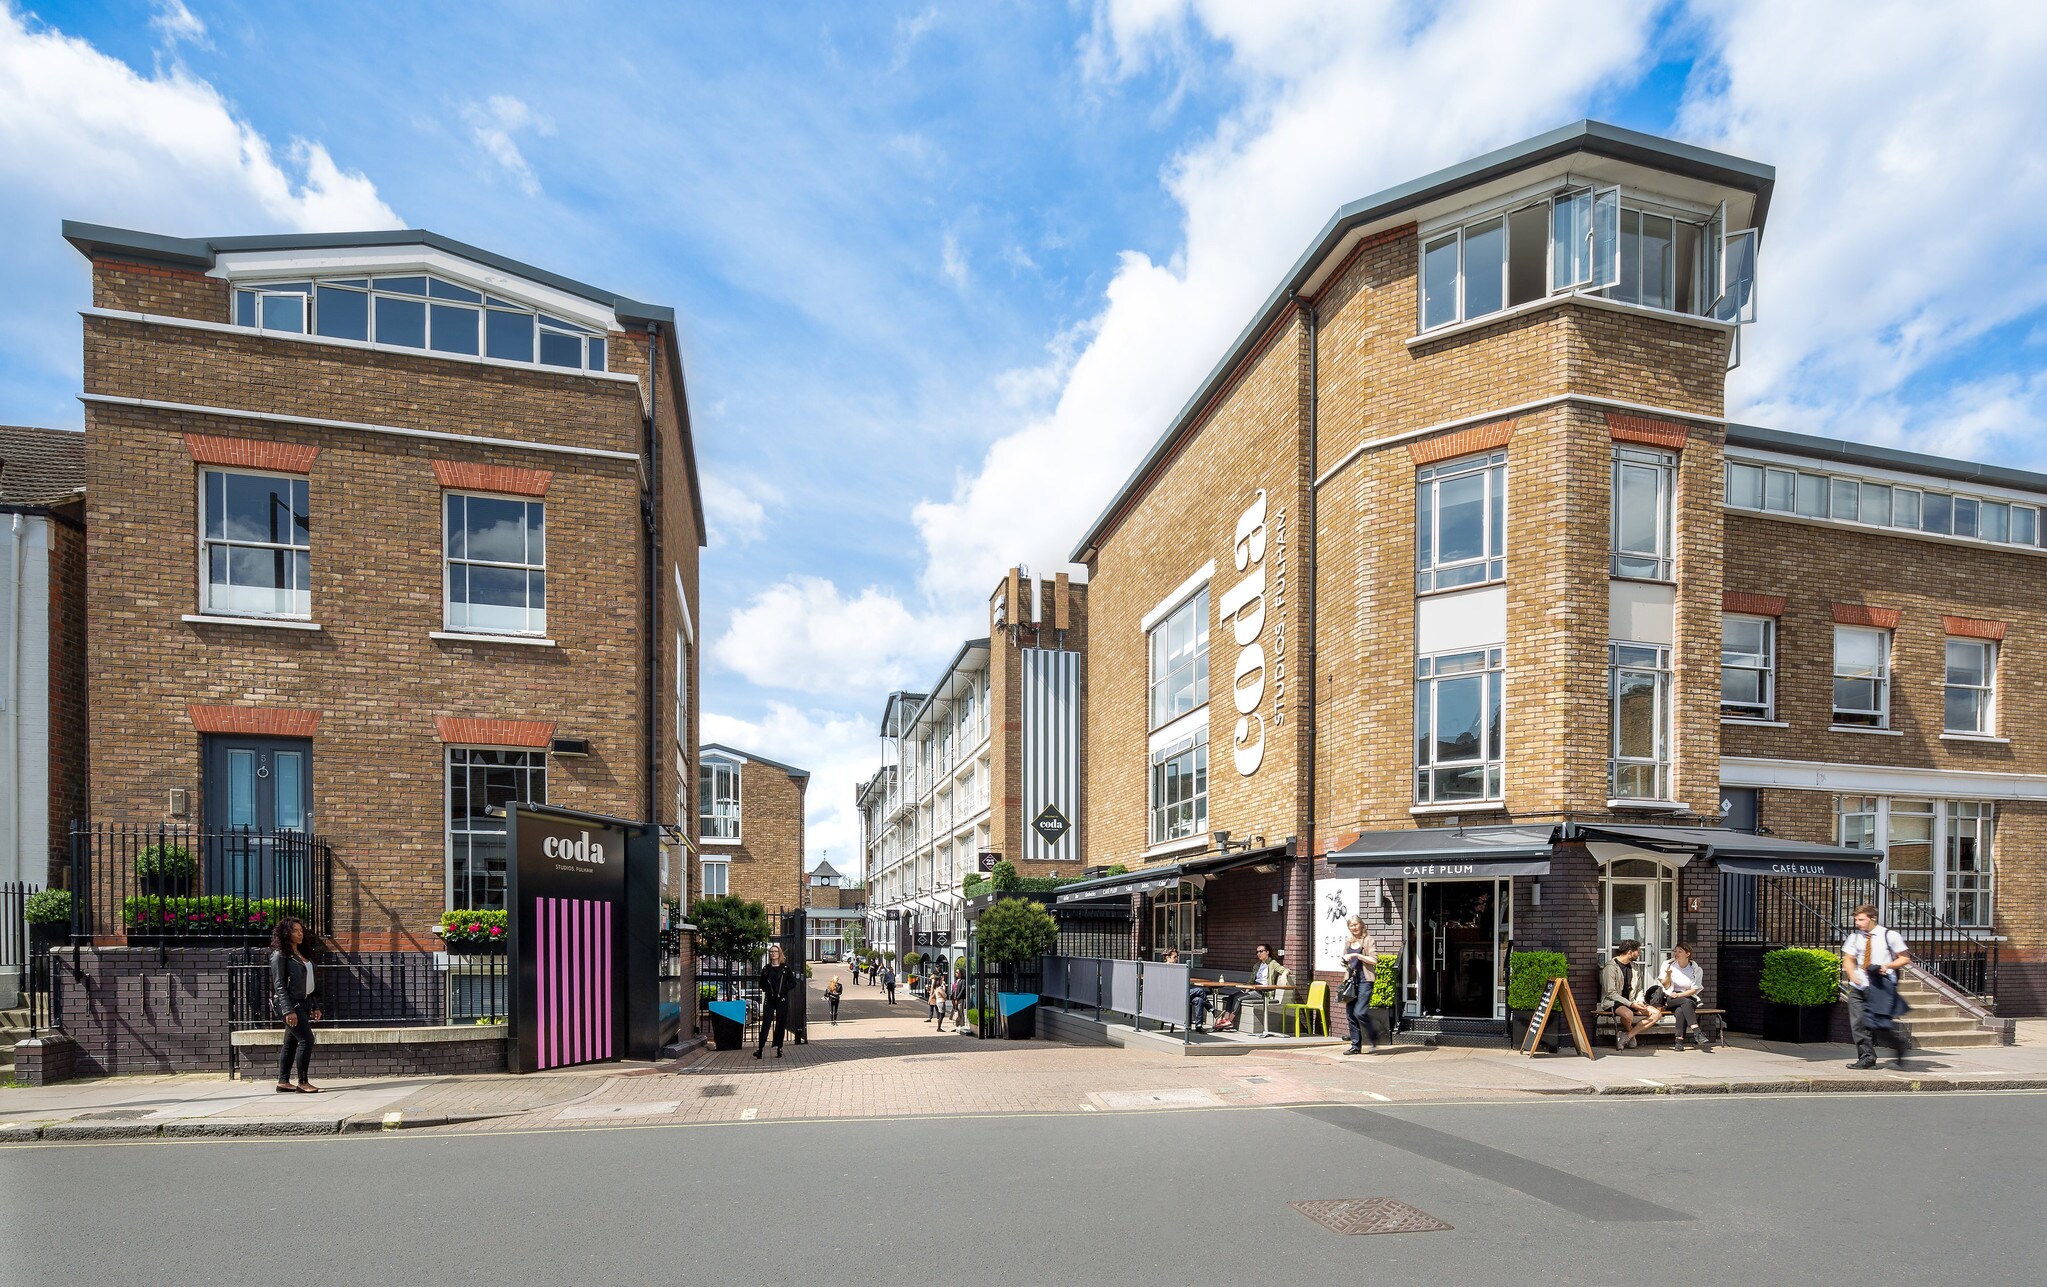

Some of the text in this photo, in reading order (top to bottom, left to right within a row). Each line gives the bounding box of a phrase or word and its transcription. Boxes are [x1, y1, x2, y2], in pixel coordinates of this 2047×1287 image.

[1274, 506, 1287, 609] FULHAM
[1220, 488, 1267, 777] coda
[261, 754, 267, 762] 5
[1040, 819, 1063, 829] coda
[543, 830, 606, 864] coda
[1403, 864, 1473, 875] CAFÉ PLUM
[1772, 863, 1825, 874] CAFÉ PLUM
[1691, 898, 1698, 911] 4
